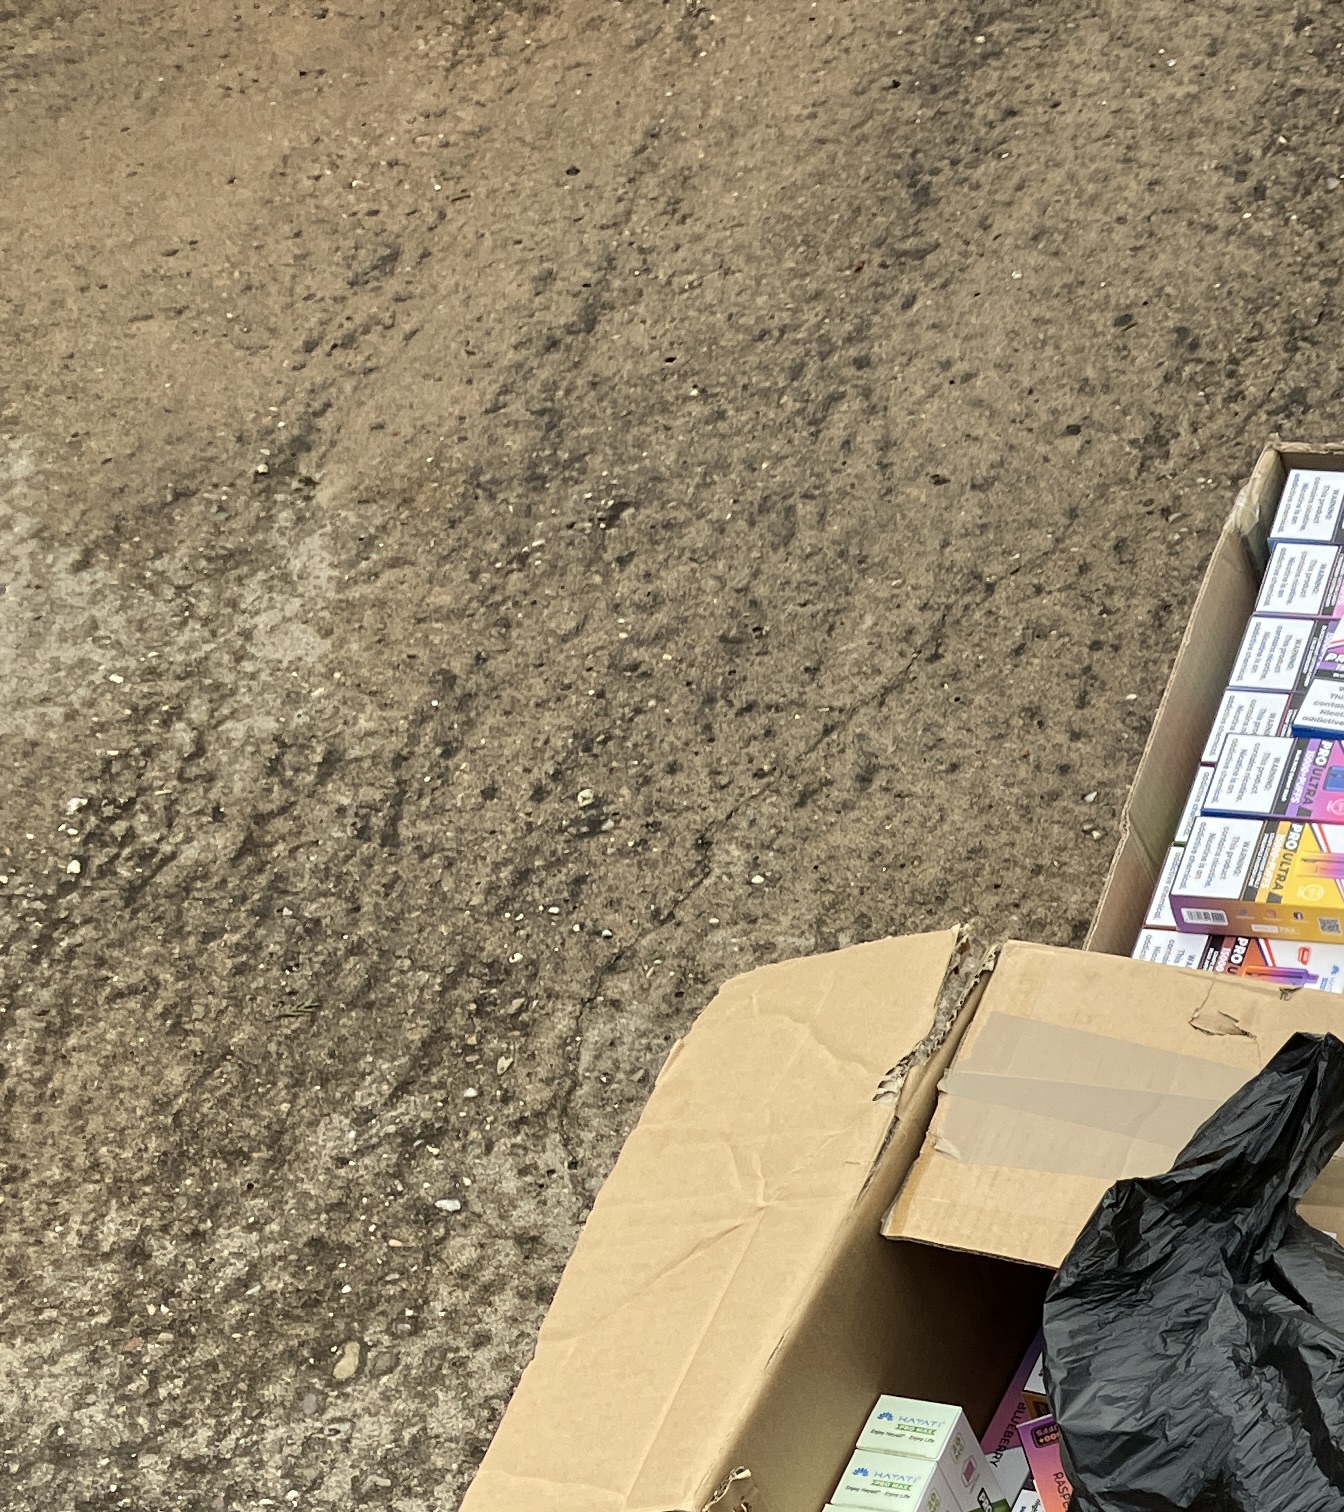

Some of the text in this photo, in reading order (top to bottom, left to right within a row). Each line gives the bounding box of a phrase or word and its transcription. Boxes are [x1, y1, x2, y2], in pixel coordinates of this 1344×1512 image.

[898, 1416, 942, 1428] HAYATI
[990, 1403, 1025, 1467] BLUEBERRY
[874, 1471, 917, 1483] HAYATI
